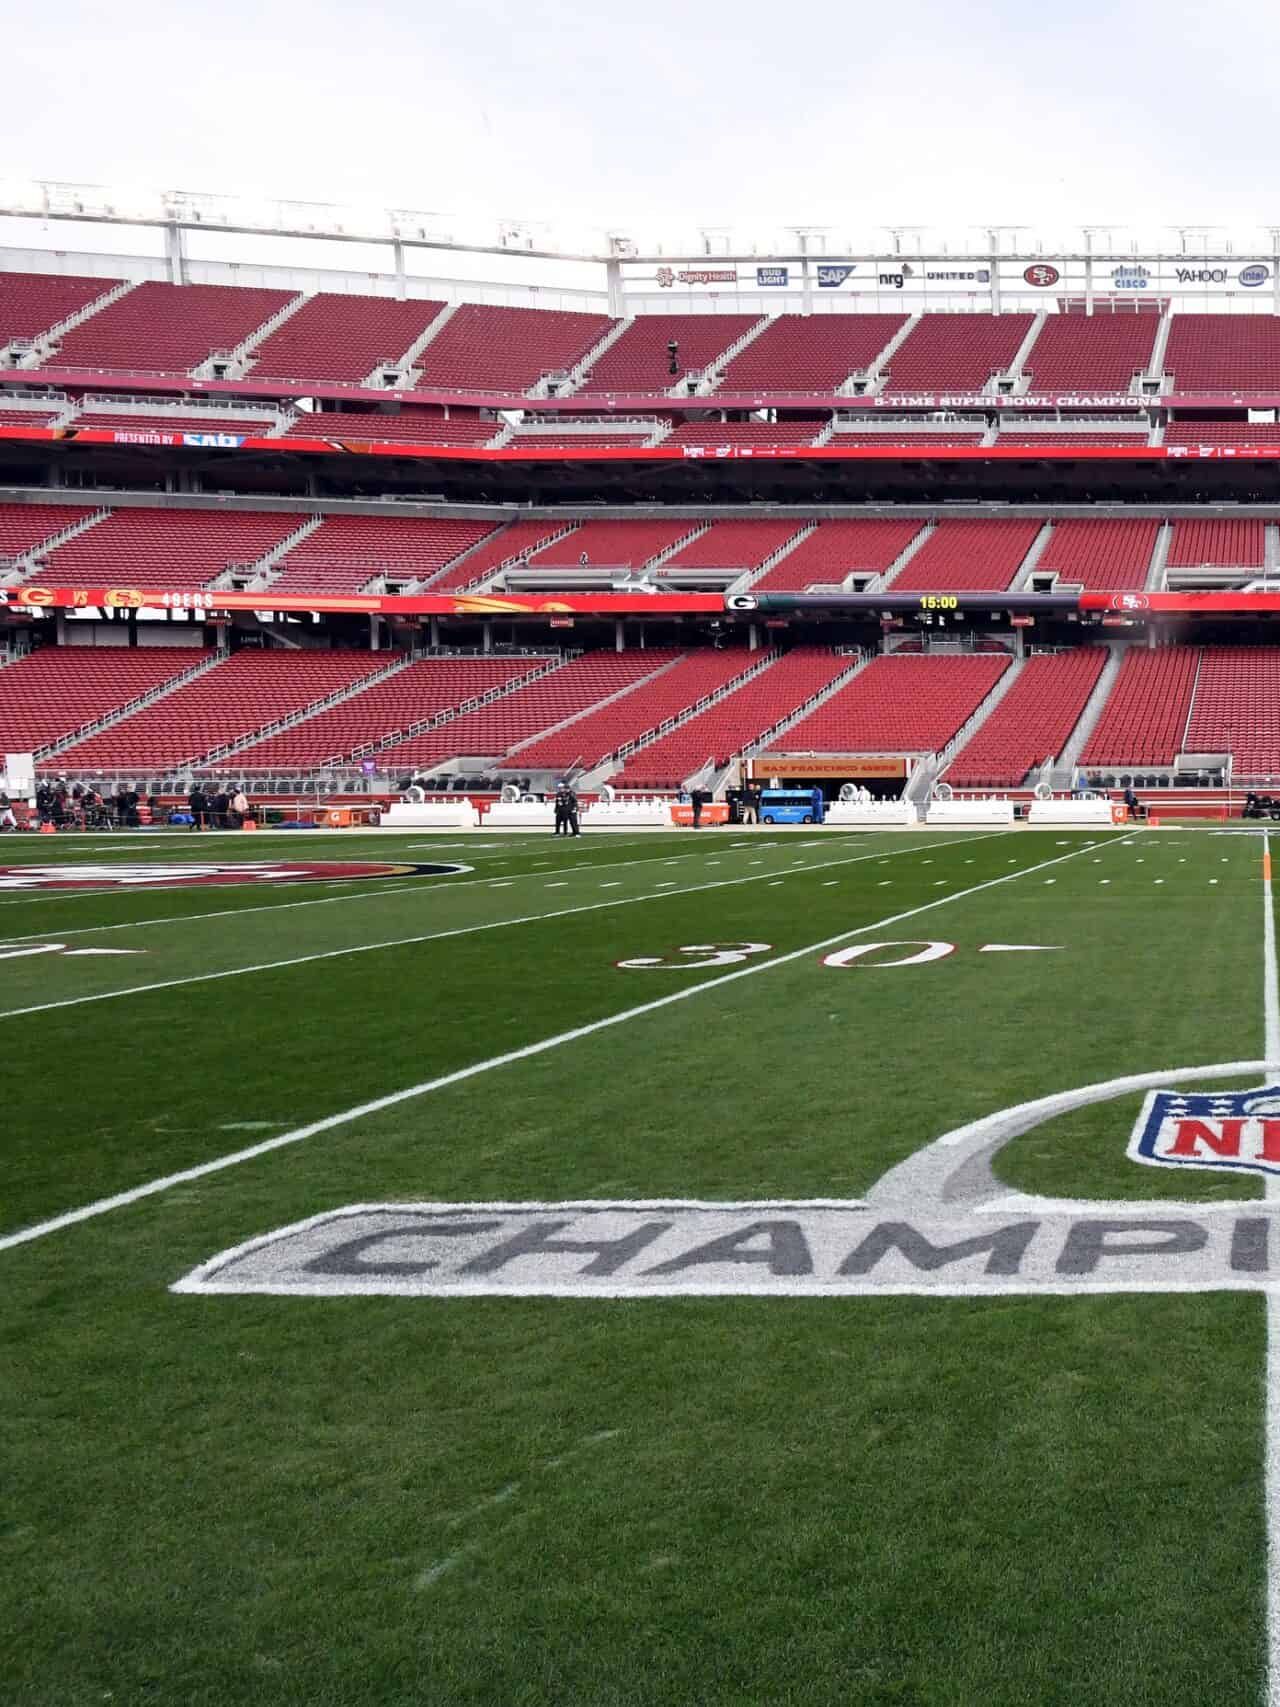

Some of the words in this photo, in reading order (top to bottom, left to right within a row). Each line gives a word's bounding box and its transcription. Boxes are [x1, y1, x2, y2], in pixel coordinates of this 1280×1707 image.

[679, 271, 708, 285] Dignity
[708, 271, 736, 282] Health
[761, 268, 782, 276] BUD
[818, 269, 847, 283] SAP
[927, 272, 975, 280] UNITED
[1176, 269, 1229, 283] YAHOO!
[758, 275, 786, 285] LIGHT
[879, 273, 904, 288] nrg
[1114, 279, 1148, 288] CISCO
[874, 396, 936, 406] 5-TIME
[939, 396, 998, 406] SUPER
[1001, 396, 1053, 406] BOWL
[1057, 396, 1162, 407] CHAMPIONS
[73, 590, 89, 605] VS
[161, 592, 214, 608] 49ERS
[919, 596, 958, 610] 15:00
